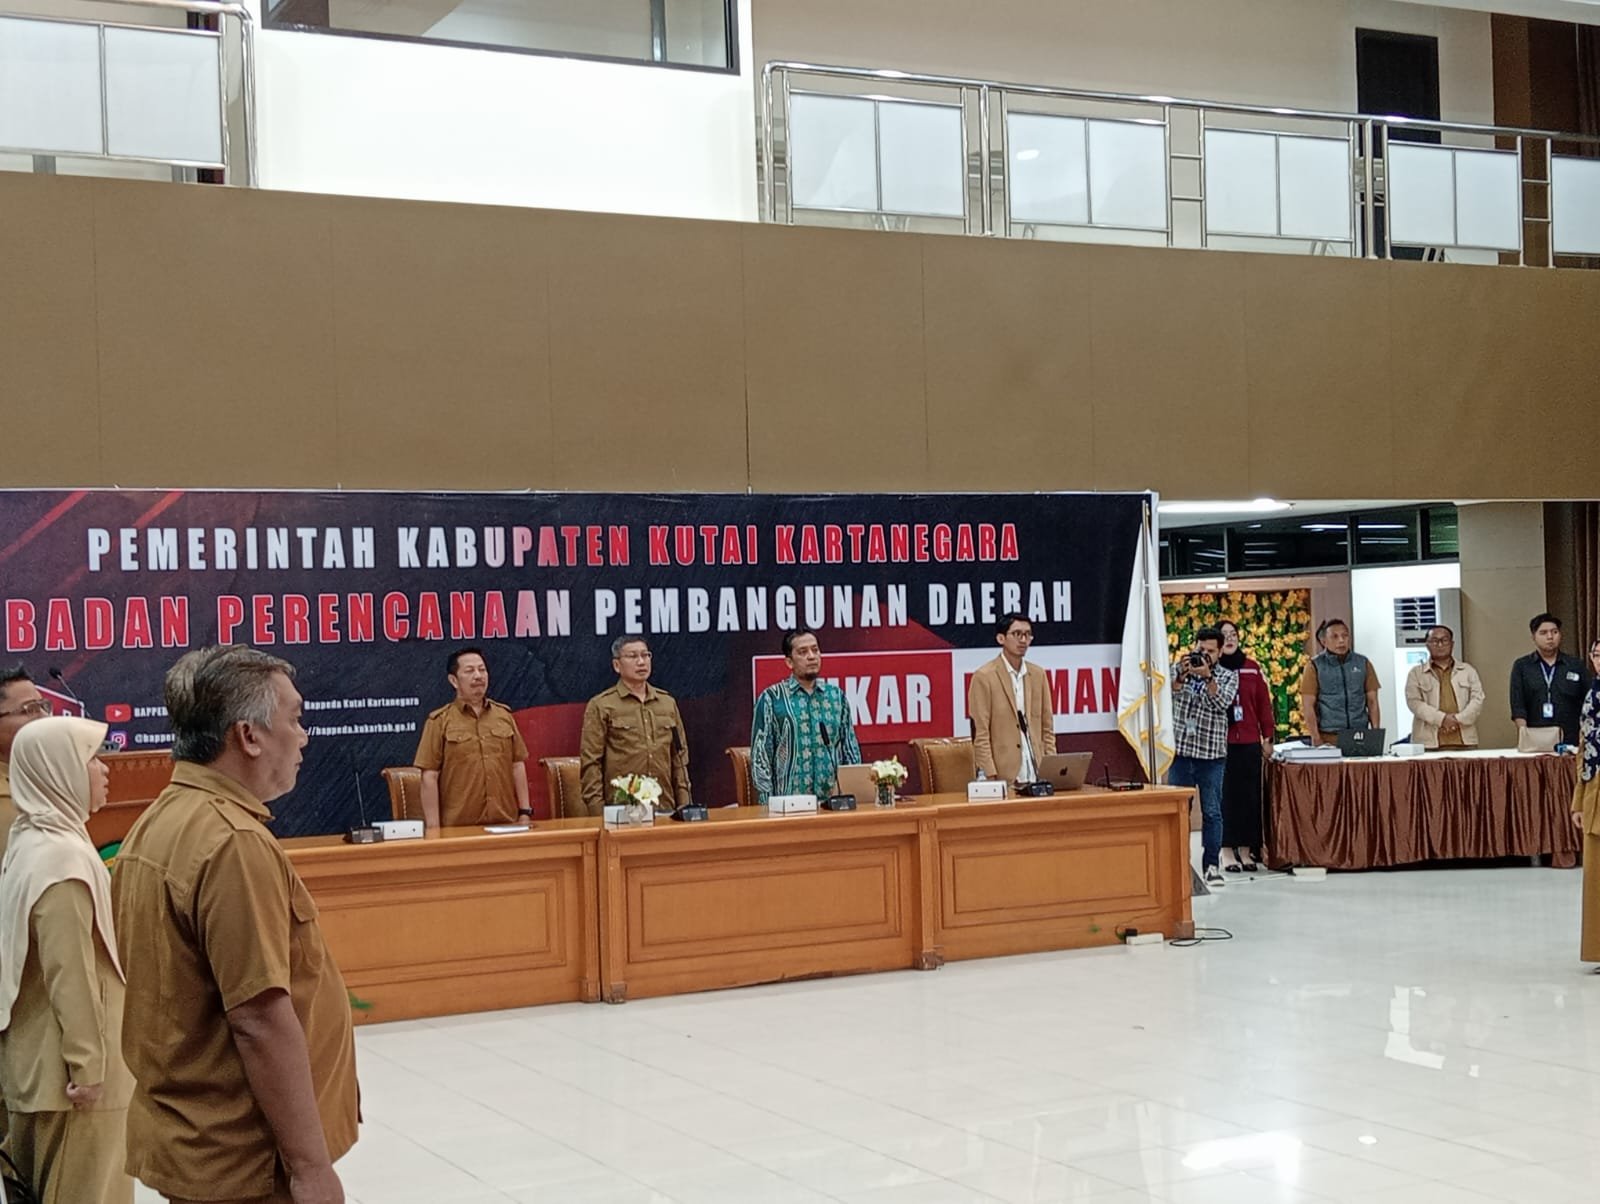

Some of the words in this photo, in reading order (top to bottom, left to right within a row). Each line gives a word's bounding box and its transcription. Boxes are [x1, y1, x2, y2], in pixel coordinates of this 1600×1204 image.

[88, 527, 376, 571] PEMERINTAH
[398, 525, 631, 568] KABUPATEN
[649, 524, 759, 566] KUTAI
[775, 522, 1020, 565] KARTANEGARA
[5, 595, 190, 652] BADAN
[217, 589, 571, 646] PERENCANAAN
[595, 583, 907, 636] PEMBANGUNAN
[928, 580, 1072, 626] DAERAH
[816, 674, 932, 726] KAR
